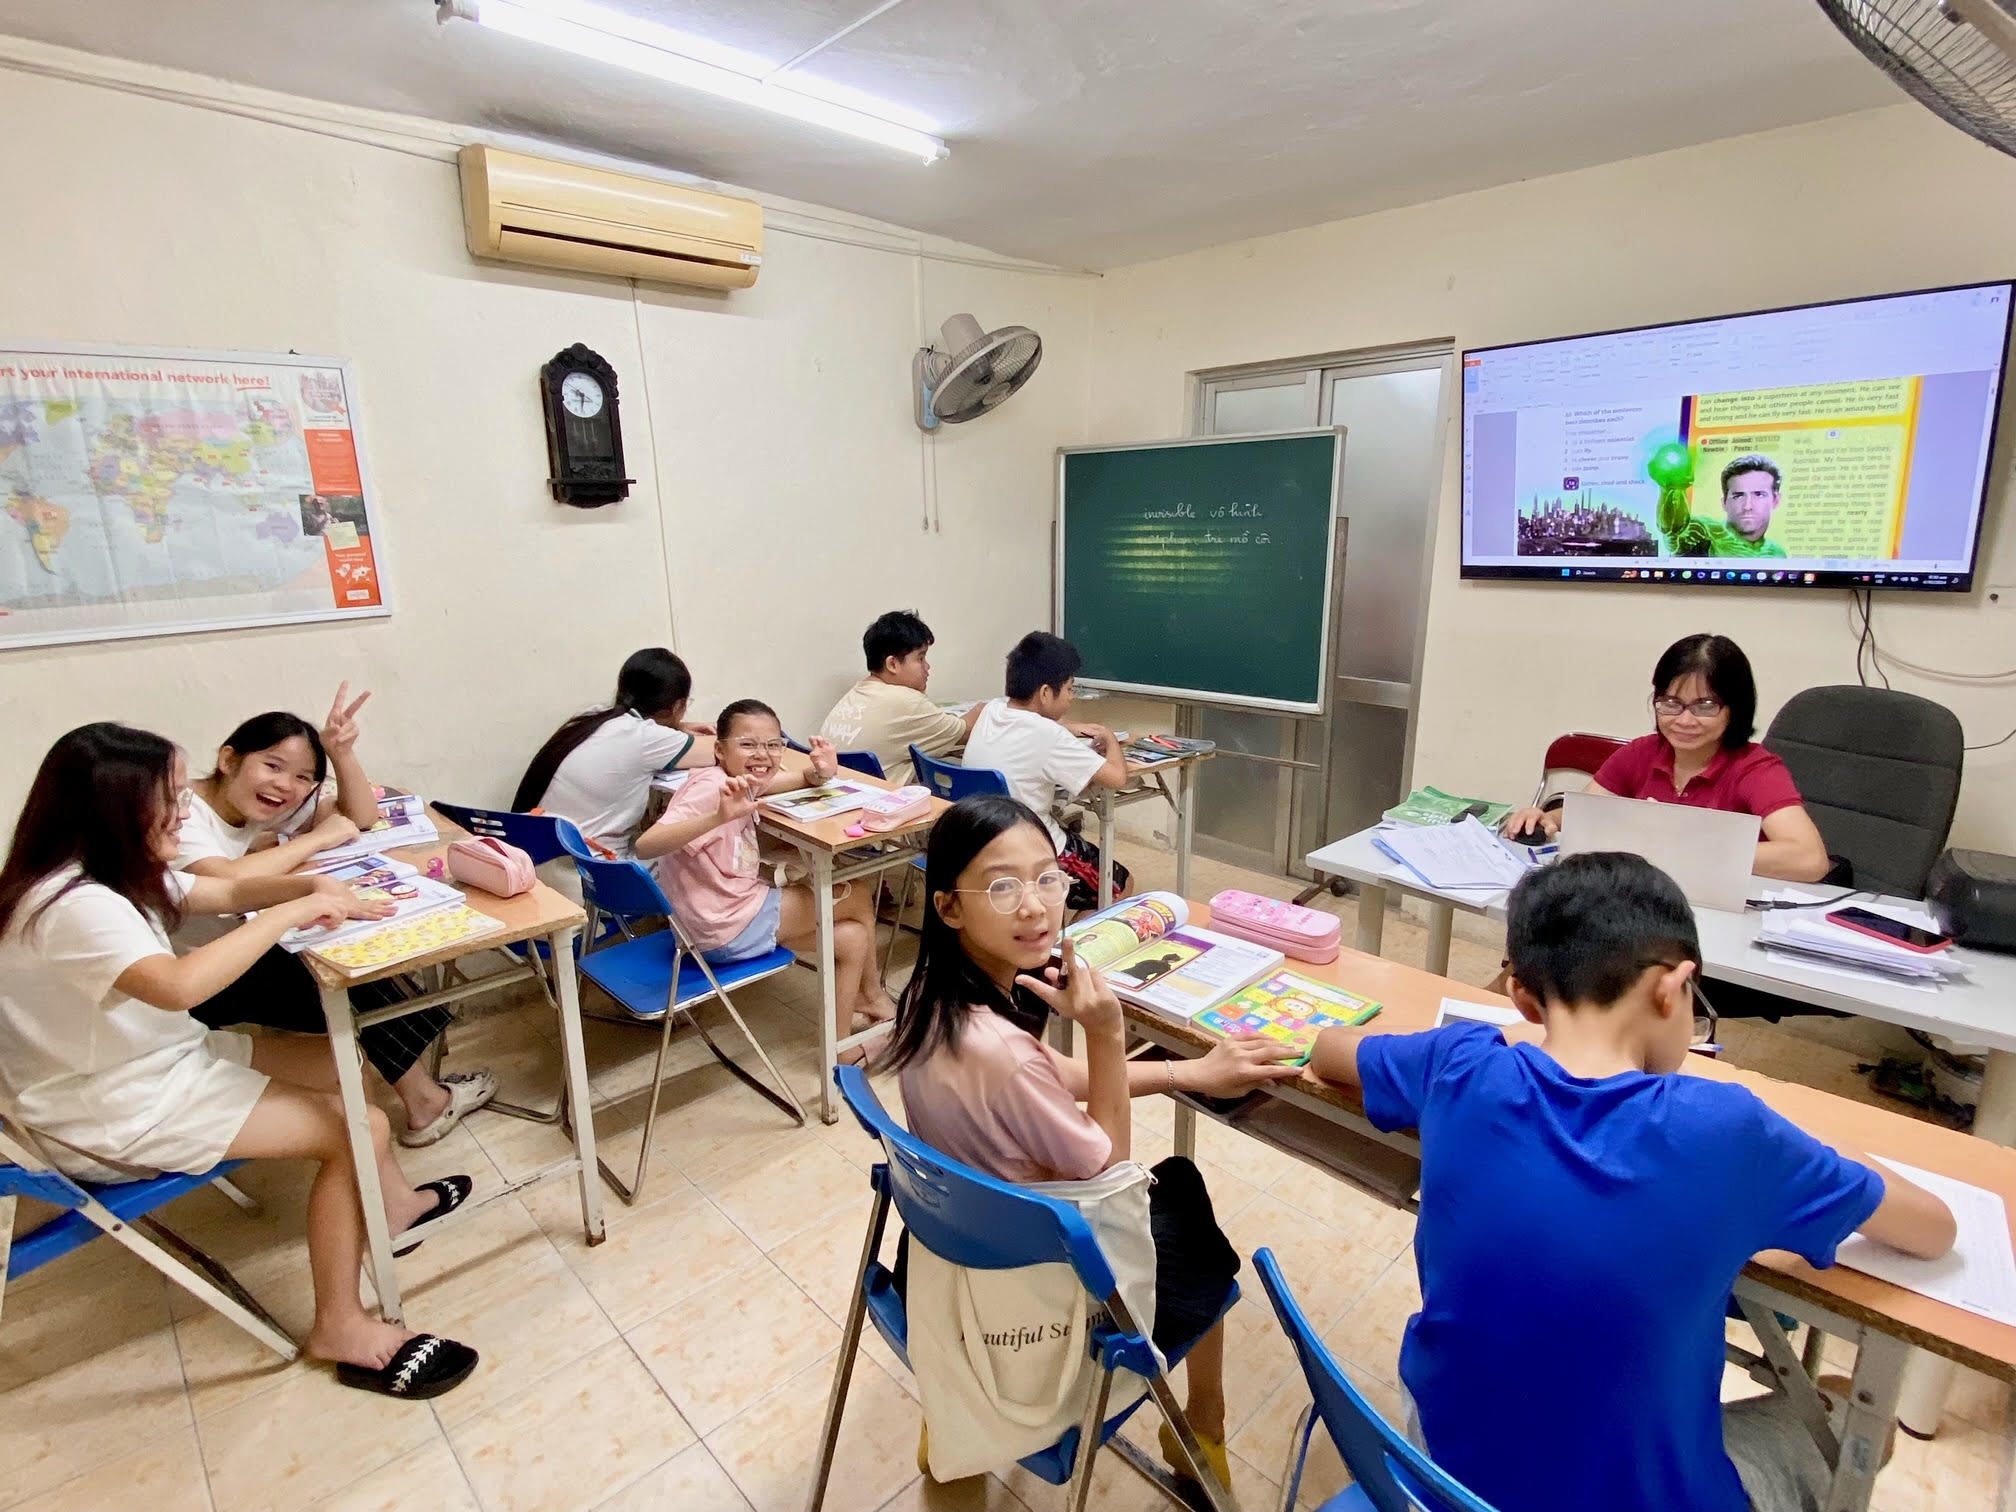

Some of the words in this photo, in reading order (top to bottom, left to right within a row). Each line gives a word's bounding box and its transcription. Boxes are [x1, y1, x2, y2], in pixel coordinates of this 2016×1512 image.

[20, 368, 57, 380] your
[63, 369, 162, 382] international
[168, 372, 229, 385] network
[233, 374, 270, 387] here!
[1144, 502, 1196, 520] invisible
